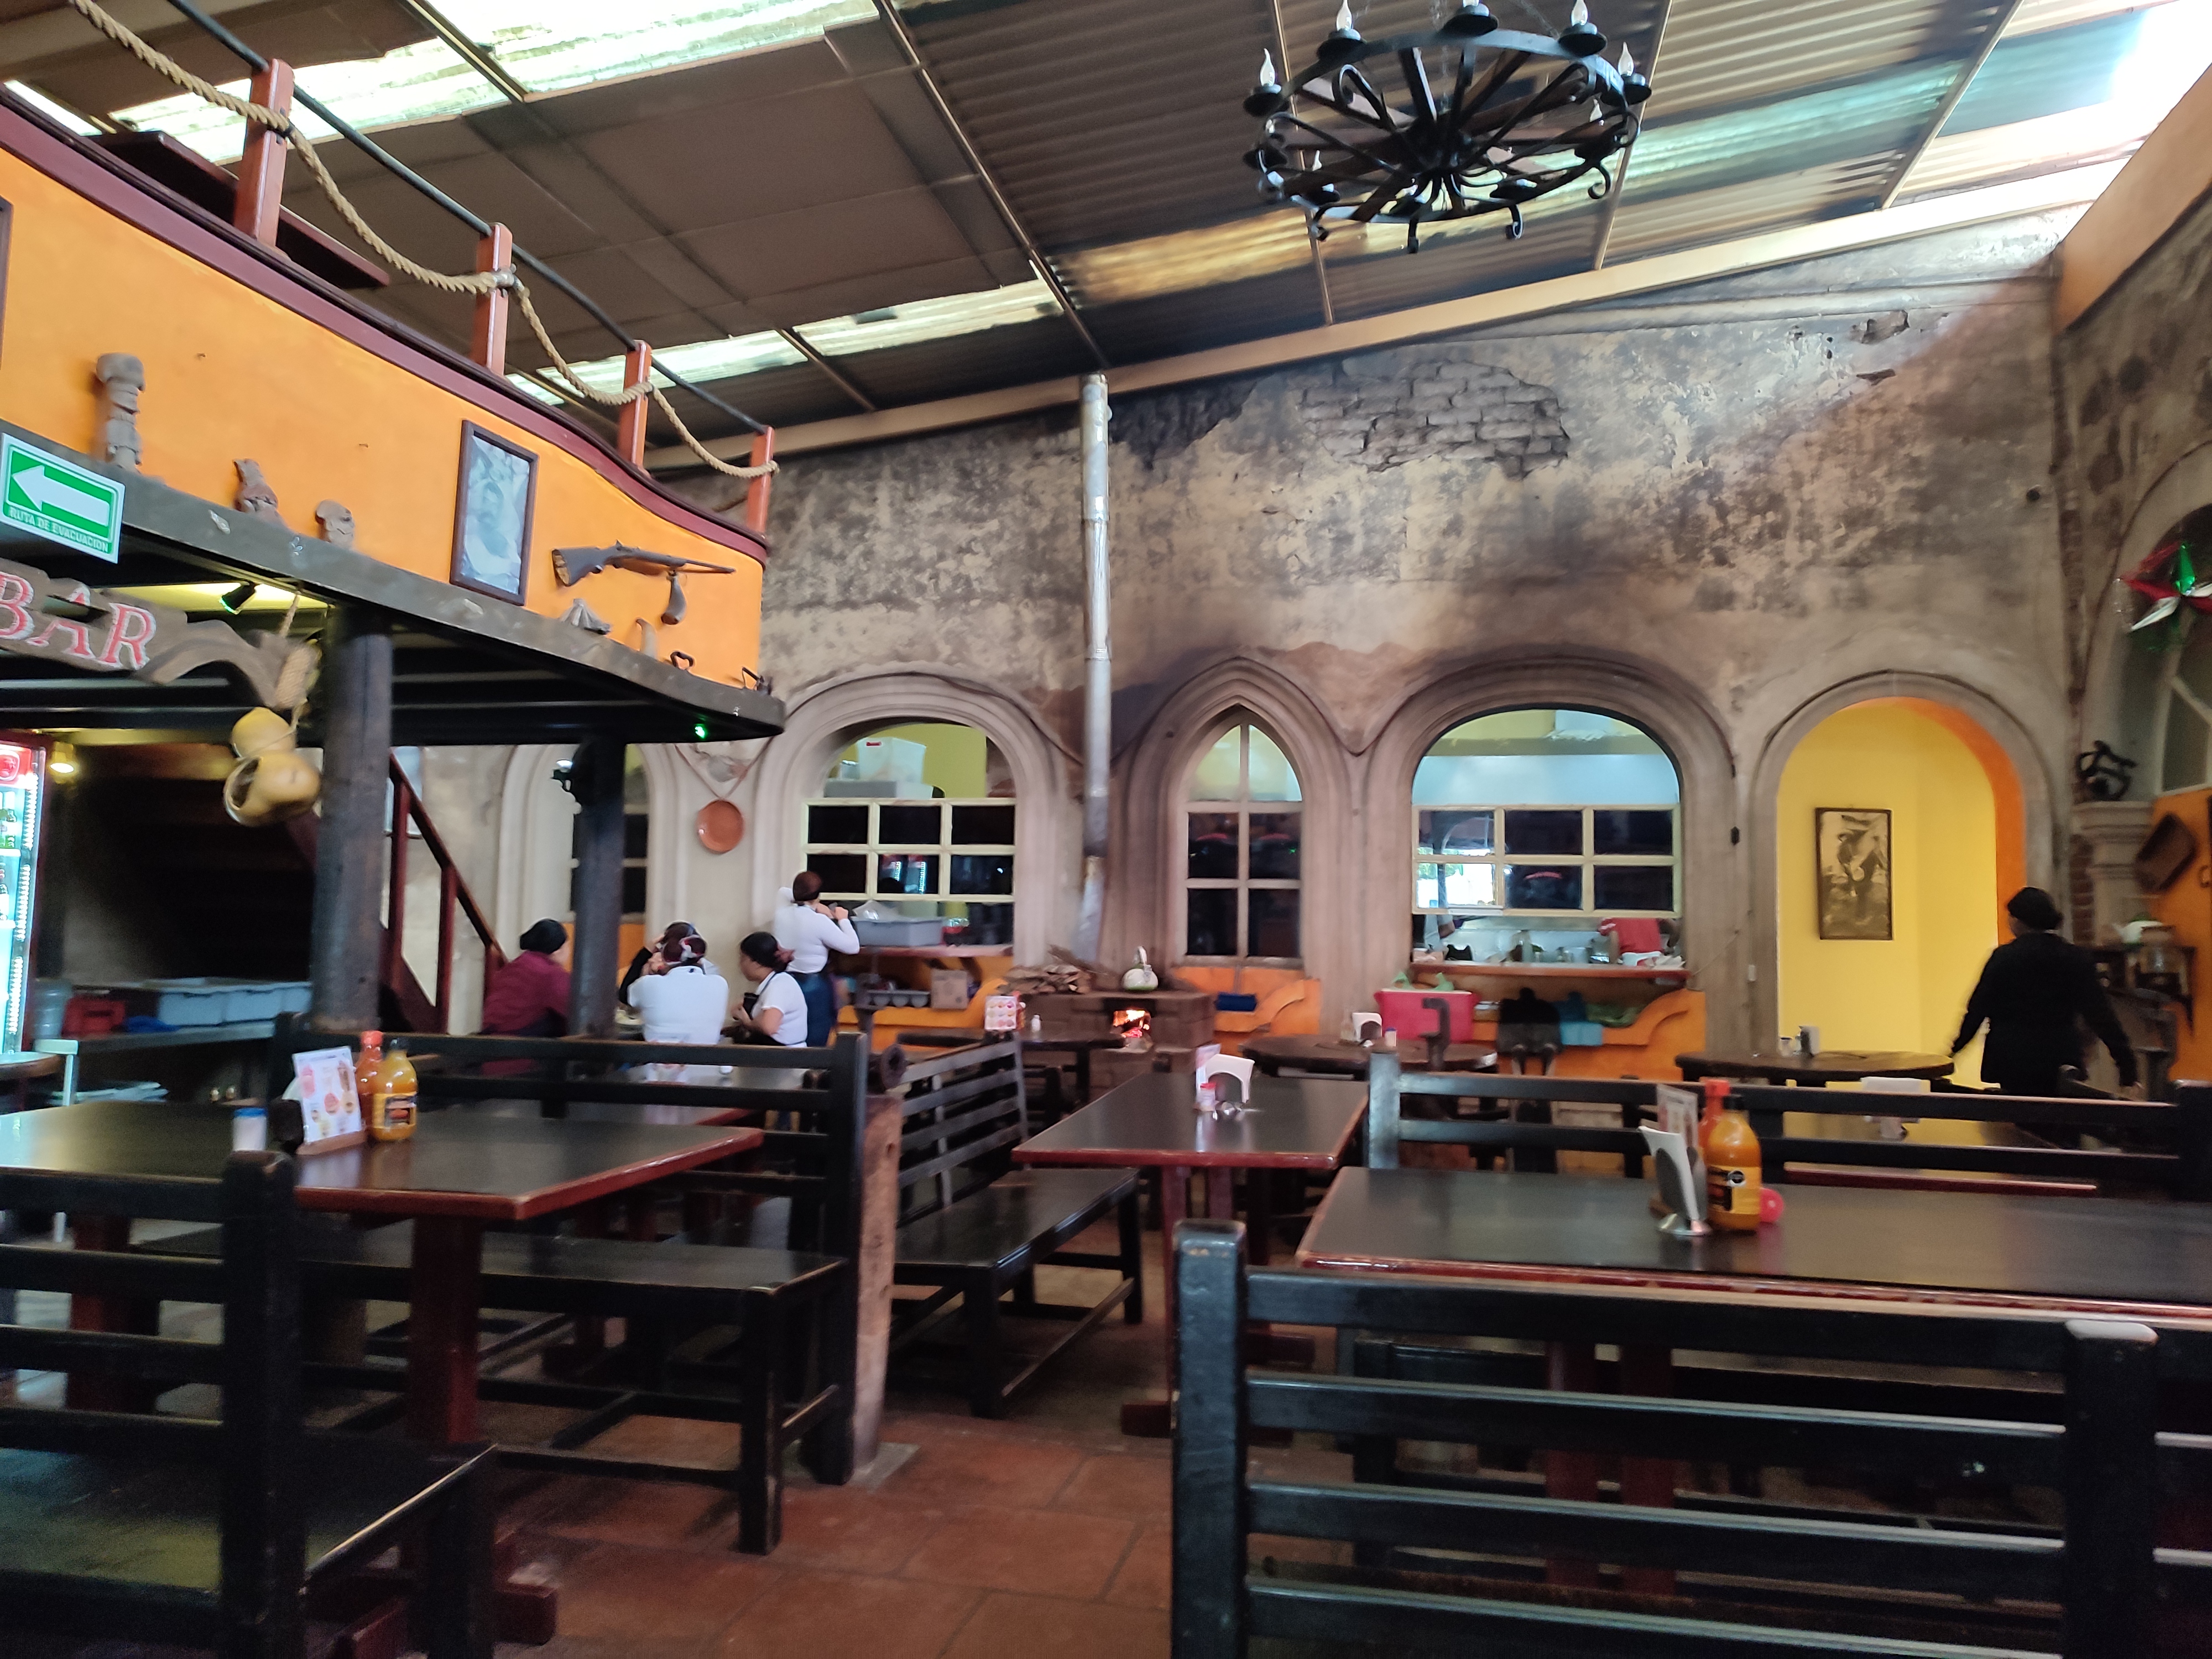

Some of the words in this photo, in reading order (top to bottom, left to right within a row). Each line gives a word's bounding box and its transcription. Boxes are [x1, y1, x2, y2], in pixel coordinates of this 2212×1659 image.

[10, 506, 35, 526] RUTA
[38, 517, 50, 530] DE
[0, 571, 156, 670] BAR
